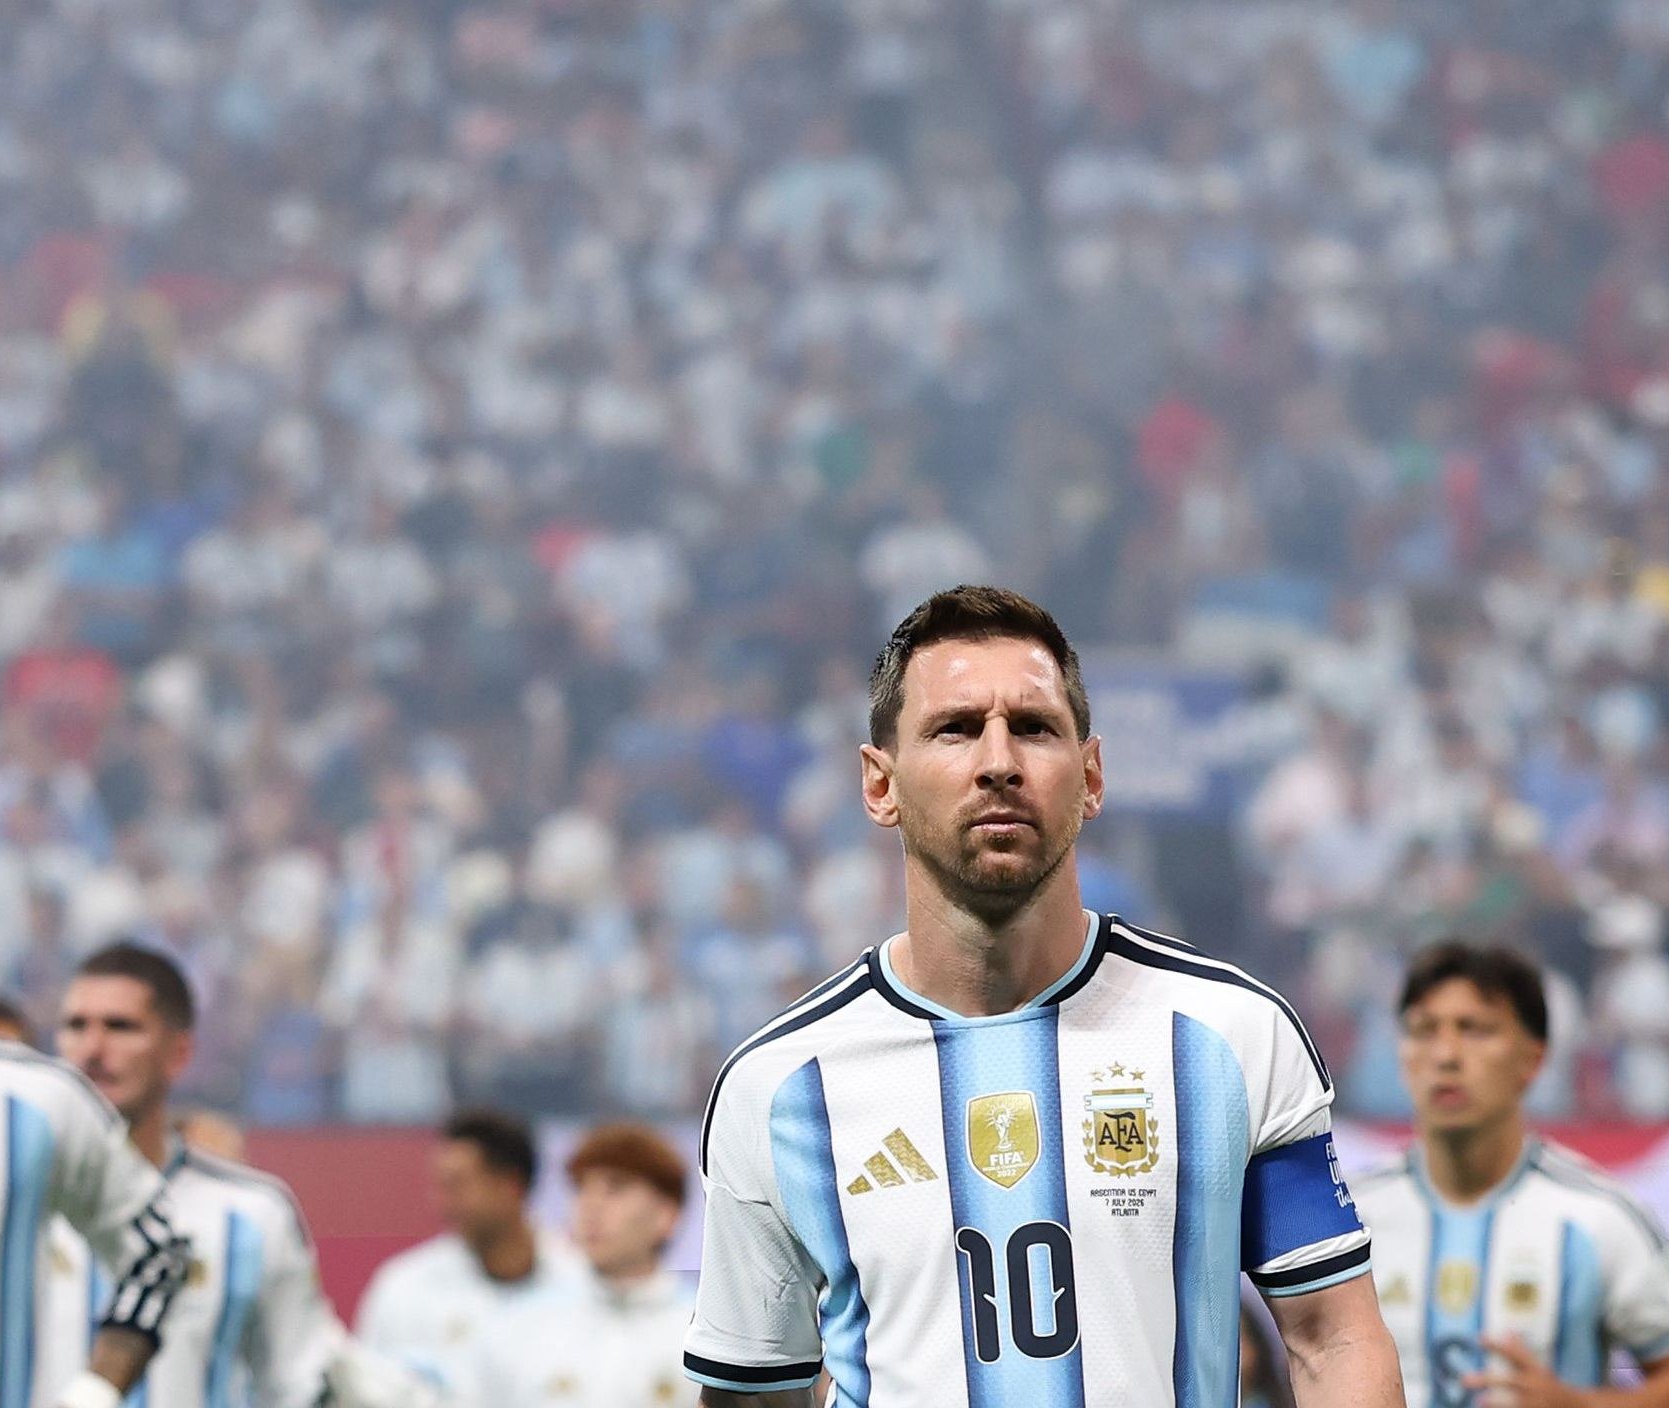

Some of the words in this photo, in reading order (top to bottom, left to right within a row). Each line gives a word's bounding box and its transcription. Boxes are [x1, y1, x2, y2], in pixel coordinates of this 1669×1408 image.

[1099, 1111, 1144, 1152] AFA
[990, 1151, 1022, 1166] FIFA
[1112, 1198, 1126, 1206] JULY
[955, 1221, 1081, 1364] 10
